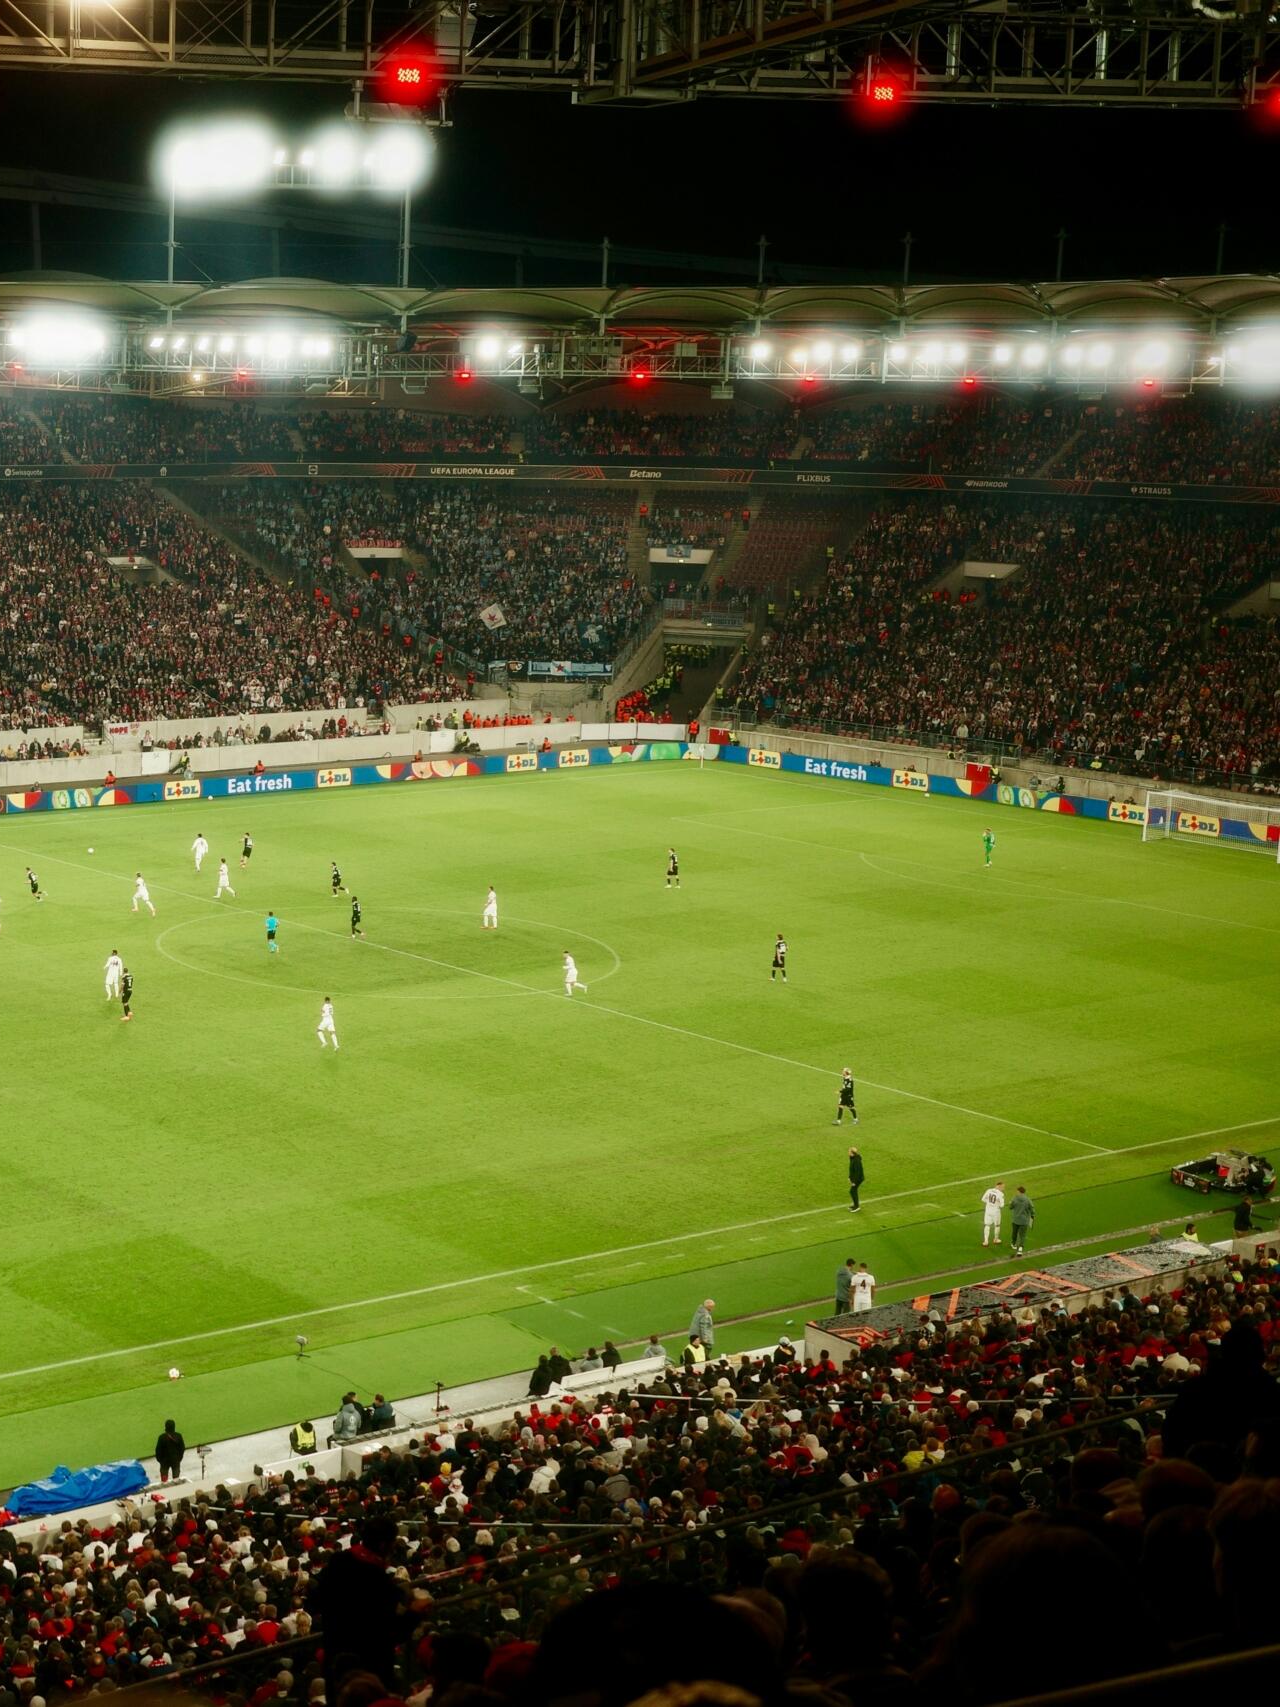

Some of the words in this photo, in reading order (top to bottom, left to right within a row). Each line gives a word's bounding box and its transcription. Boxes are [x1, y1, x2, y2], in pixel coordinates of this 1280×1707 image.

[430, 467, 451, 475] UEFA
[452, 467, 483, 476] EUROPA
[484, 468, 515, 476] LEAGUE
[629, 469, 662, 479] Betano
[1138, 486, 1172, 495] STRAUSS
[508, 755, 536, 768] LIDL
[561, 751, 588, 764] LIDL
[750, 751, 779, 766] LIDL
[805, 758, 829, 774] Eat
[830, 760, 867, 781] fresh
[319, 770, 350, 784] LIDL
[894, 772, 927, 788] LIDL
[166, 782, 199, 797] LIDL
[227, 778, 252, 794] Eat
[254, 774, 292, 791] fresh
[1180, 815, 1218, 833] LIDL
[988, 1192, 998, 1204] 10
[859, 1279, 866, 1290] 4
